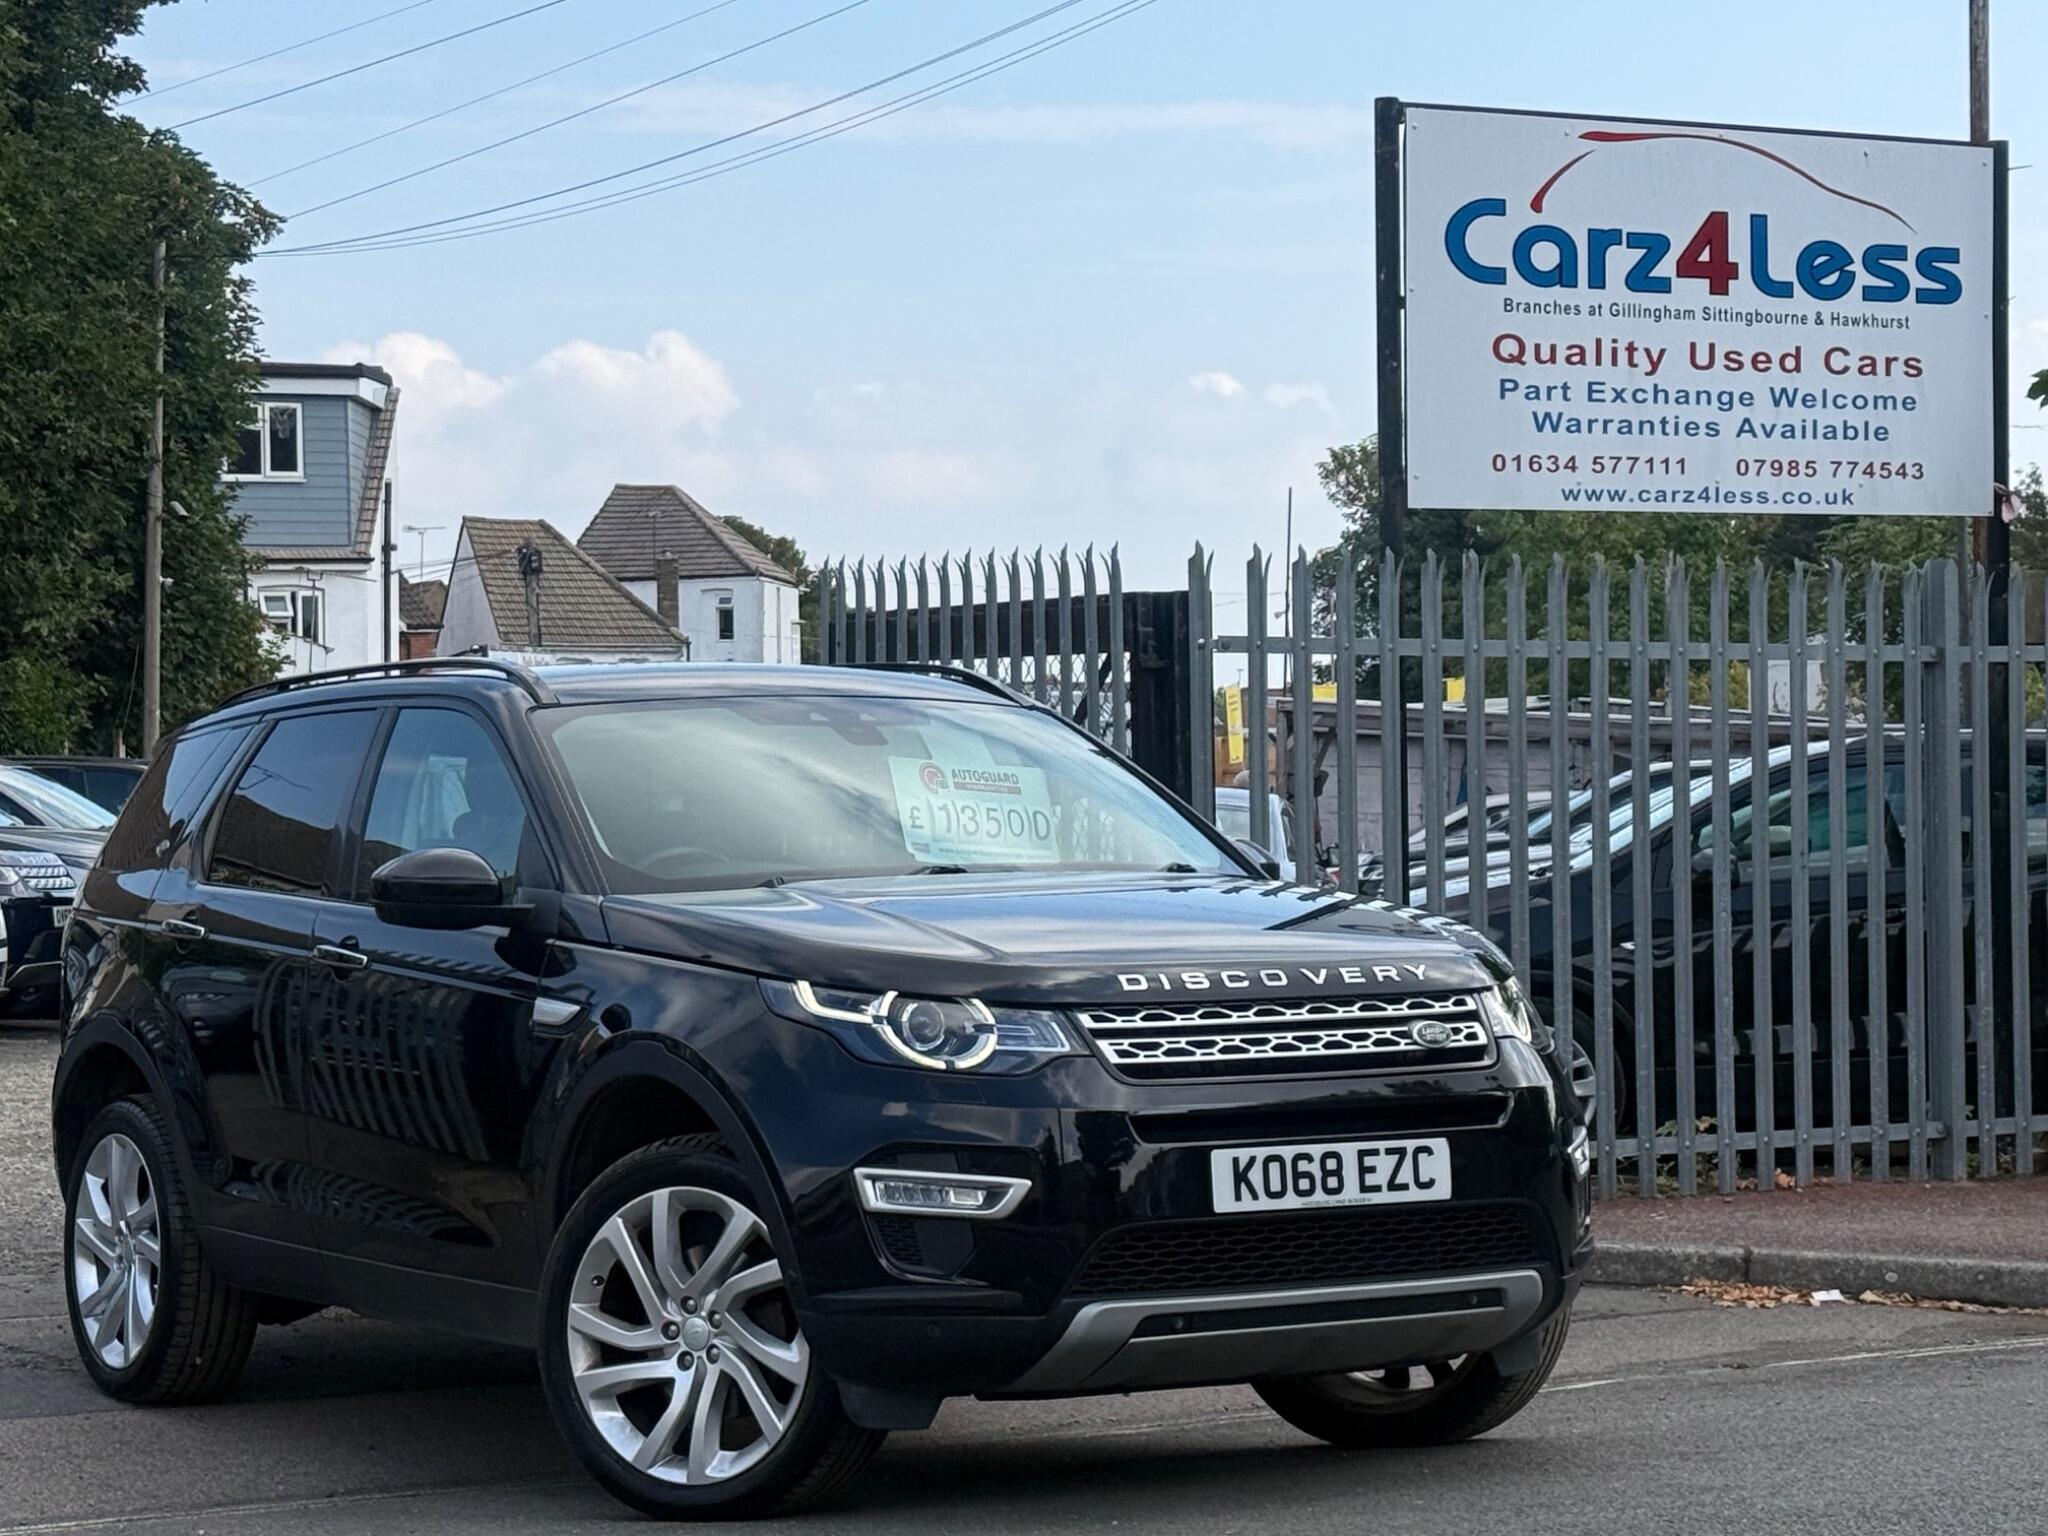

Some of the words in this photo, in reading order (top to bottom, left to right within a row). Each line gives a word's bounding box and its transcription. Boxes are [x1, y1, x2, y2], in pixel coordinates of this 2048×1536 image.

[1444, 198, 1962, 305] Carz4Less
[1503, 298, 1583, 317] Branches
[1587, 303, 1604, 317] at
[1608, 301, 1697, 323] Gillingham
[1701, 306, 1811, 327] Sittingbourne
[1814, 311, 1825, 327] &
[1830, 312, 1910, 330] Hawkhurst
[1493, 332, 1668, 377] Quality
[1689, 341, 1802, 374] Used
[1823, 346, 1924, 379] Cars
[1499, 378, 1572, 403] Part
[1587, 381, 1755, 413] Exchange
[1769, 387, 1918, 412] Welcome
[1532, 410, 1721, 438] Warranties
[1736, 416, 1890, 442] Available
[1492, 453, 1579, 474] 01634
[1592, 455, 1686, 476] 577111
[1736, 458, 1818, 478] 07985
[1830, 460, 1925, 481] 774543
[1561, 485, 1855, 506] www.carz4less.co.uk
[951, 768, 1019, 785] AUTOGUARD
[1117, 964, 1427, 992] DISCOVERY
[1357, 1145, 1436, 1194] EZC
